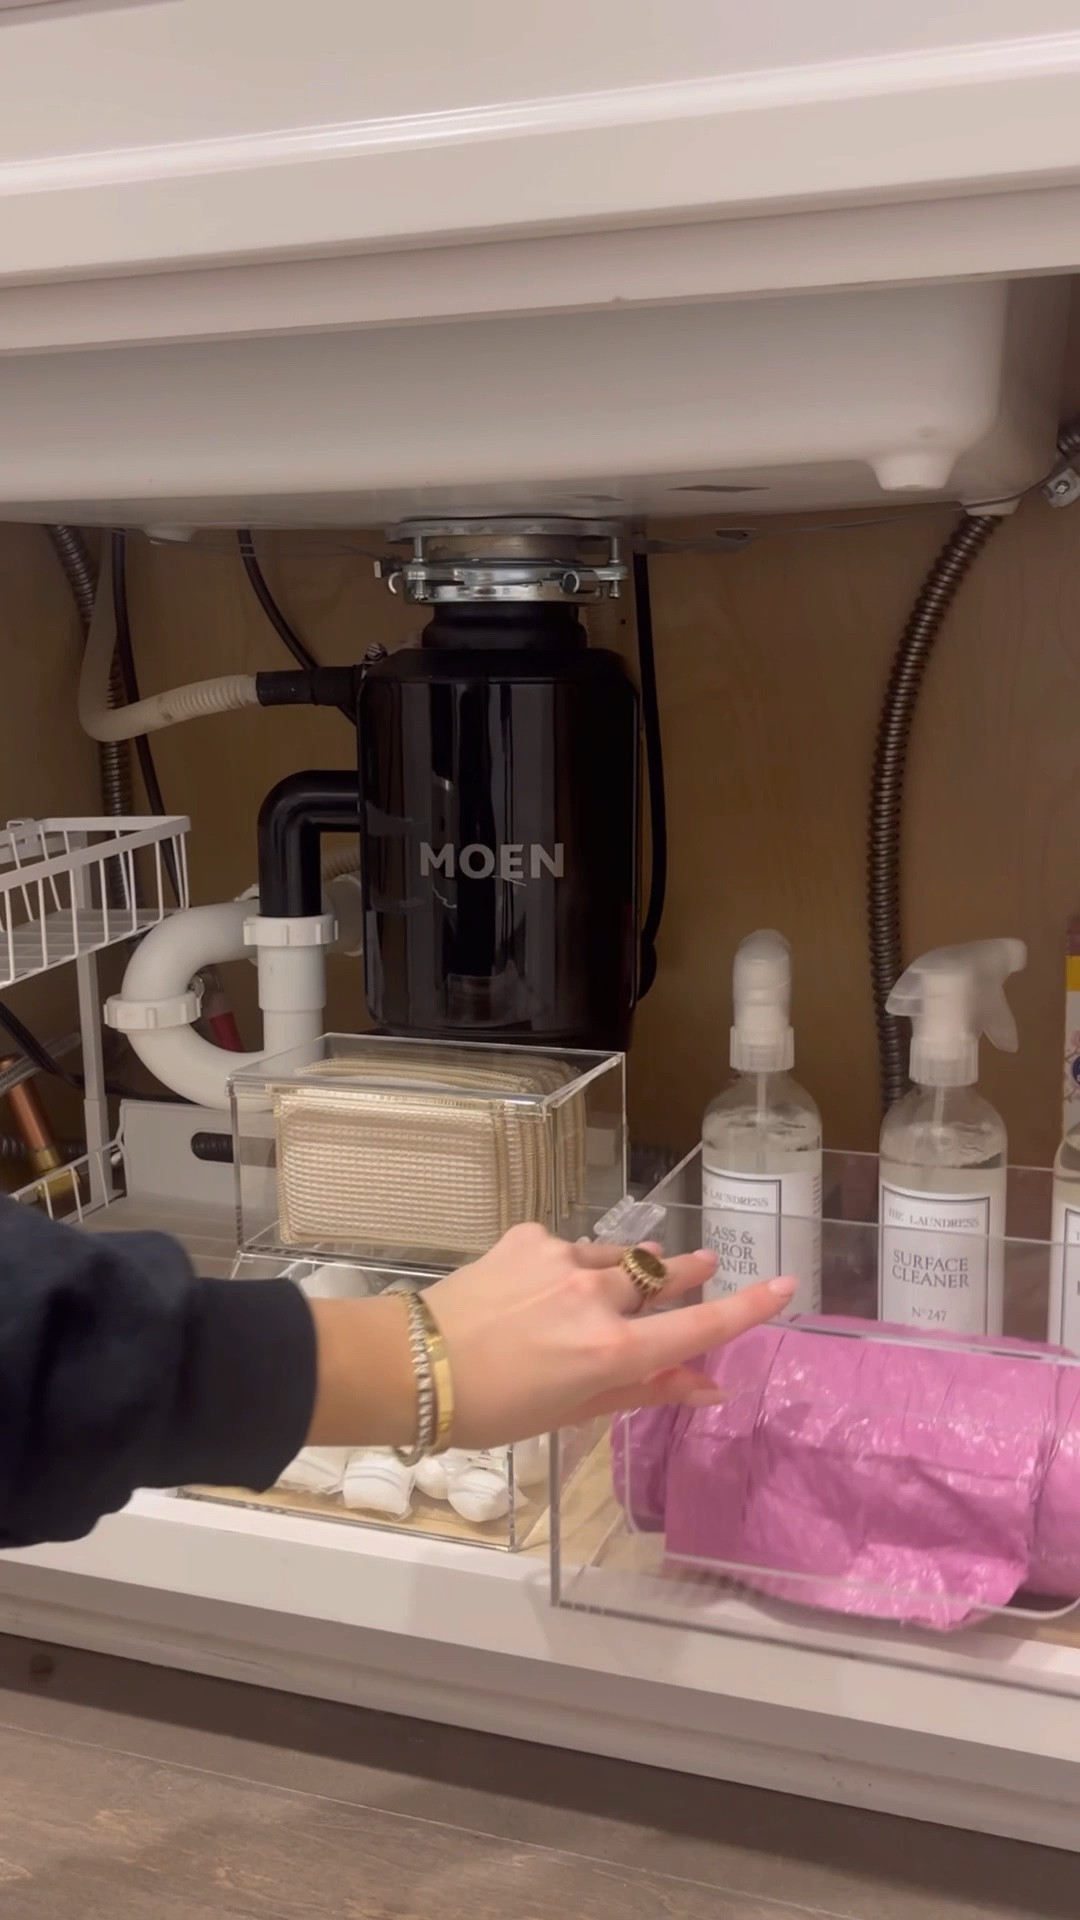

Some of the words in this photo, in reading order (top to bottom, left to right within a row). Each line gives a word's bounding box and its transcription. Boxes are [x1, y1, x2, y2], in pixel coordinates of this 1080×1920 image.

[420, 842, 564, 879] MOEN
[909, 1213, 981, 1228] LAUNDRESS
[740, 1230, 756, 1246] &
[717, 1255, 760, 1276] ANER
[892, 1248, 969, 1273] SURFACE
[891, 1263, 971, 1289] CLEANER
